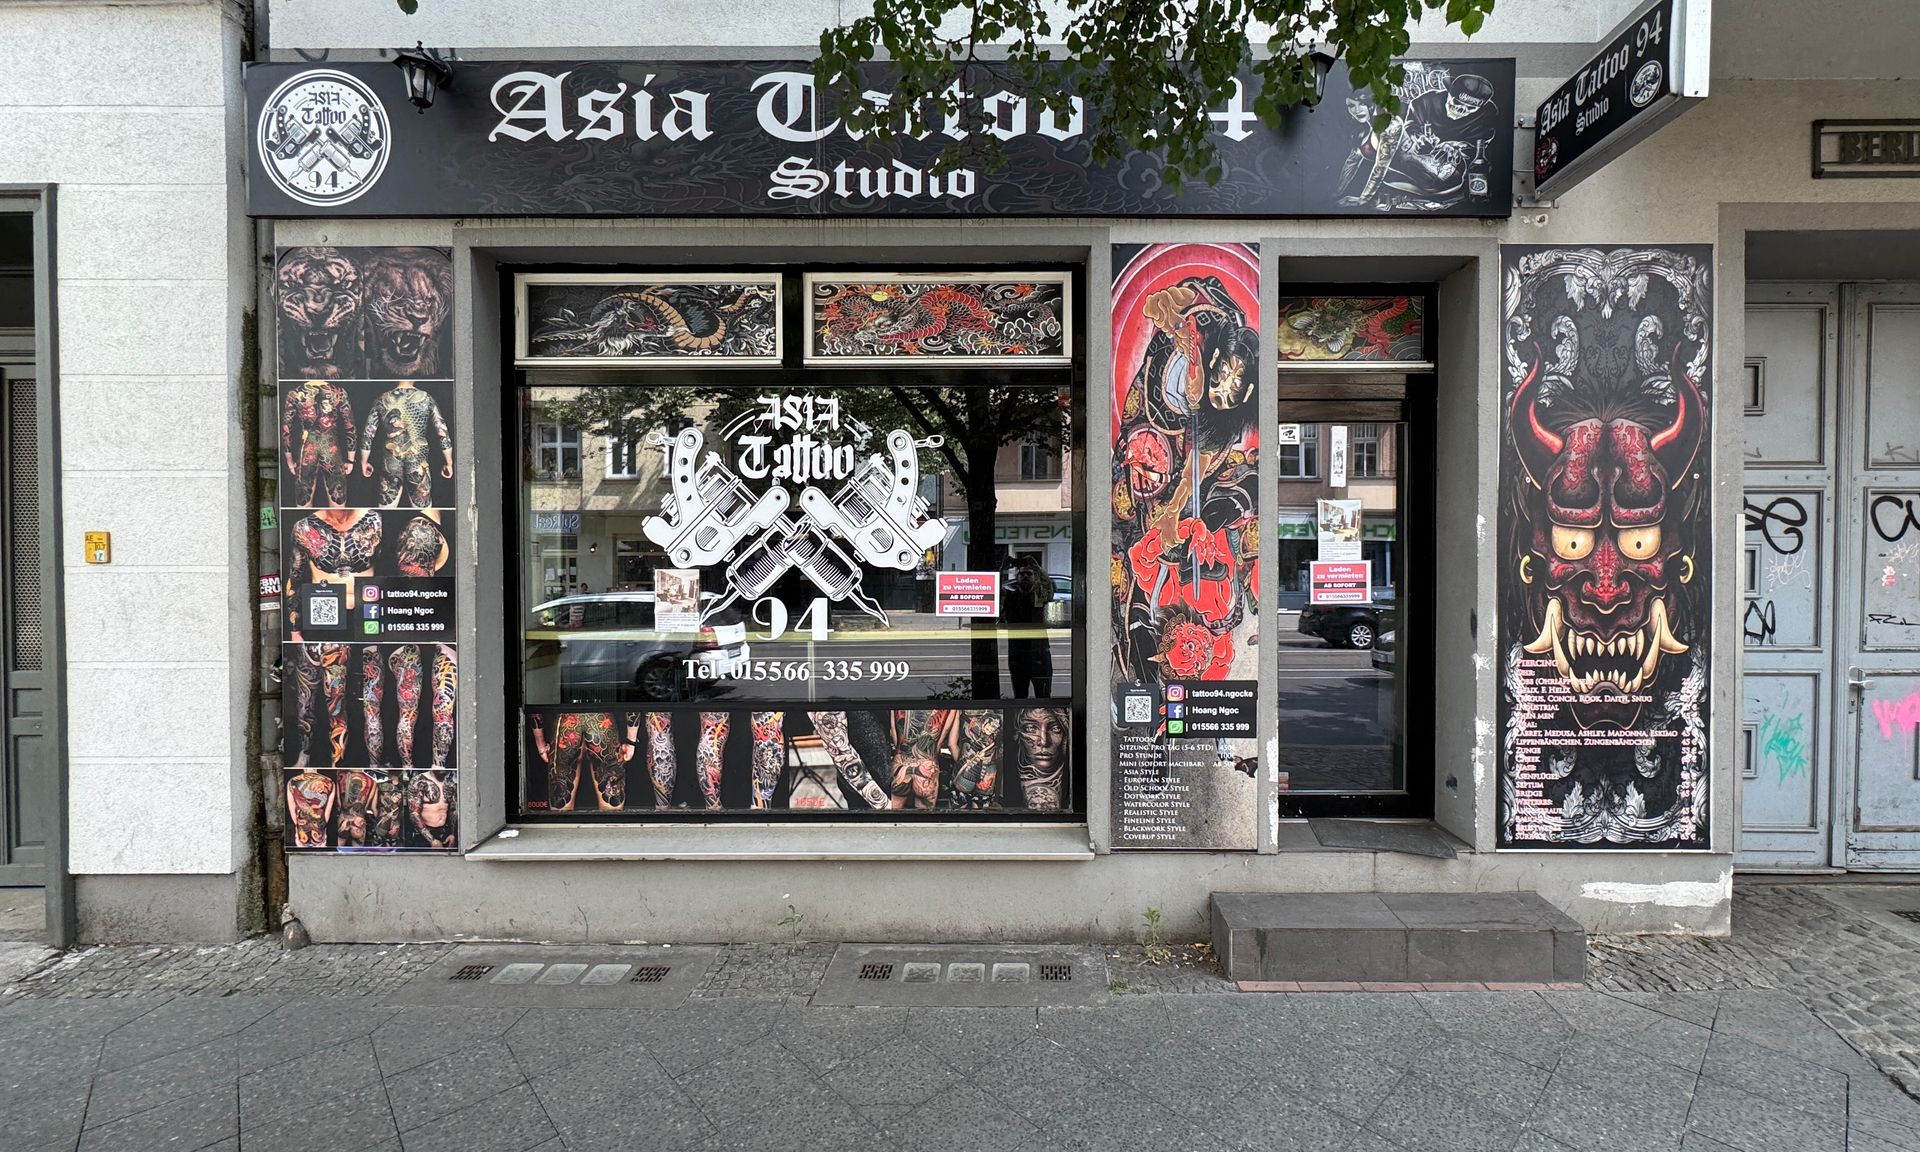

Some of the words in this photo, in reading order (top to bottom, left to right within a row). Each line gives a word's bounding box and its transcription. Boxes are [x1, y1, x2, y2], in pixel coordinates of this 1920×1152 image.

[1539, 90, 1571, 139] Asia
[1575, 44, 1629, 106] Tattoo
[1636, 10, 1662, 58] 94
[488, 70, 713, 143] Asia
[1575, 95, 1609, 136] Studio
[301, 106, 347, 126] Tattoo
[308, 171, 340, 188] 94
[766, 155, 976, 200] Studio
[753, 392, 841, 433] ASIA
[738, 434, 855, 484] Tattoo
[387, 589, 448, 599] tattoo94.ngocke
[387, 606, 412, 616] Hoang
[414, 606, 434, 616] Ngoc
[752, 596, 835, 641] 94
[387, 623, 414, 631] 015566
[415, 623, 430, 631] 335
[430, 623, 445, 631] 999
[682, 659, 726, 680] Tel.
[730, 660, 810, 681] 015566
[823, 661, 864, 681] 335
[870, 661, 910, 681] 999
[1516, 659, 1558, 667] PIERCING
[1192, 690, 1253, 699] tattoo94.ngocke
[1192, 706, 1218, 716] Hoang
[1219, 706, 1239, 716] Ngoc
[1192, 723, 1219, 731] 015566
[1220, 723, 1234, 731] 335
[1236, 723, 1250, 731] 999
[1583, 738, 1655, 746] ZUNGENBÄNDCHEN
